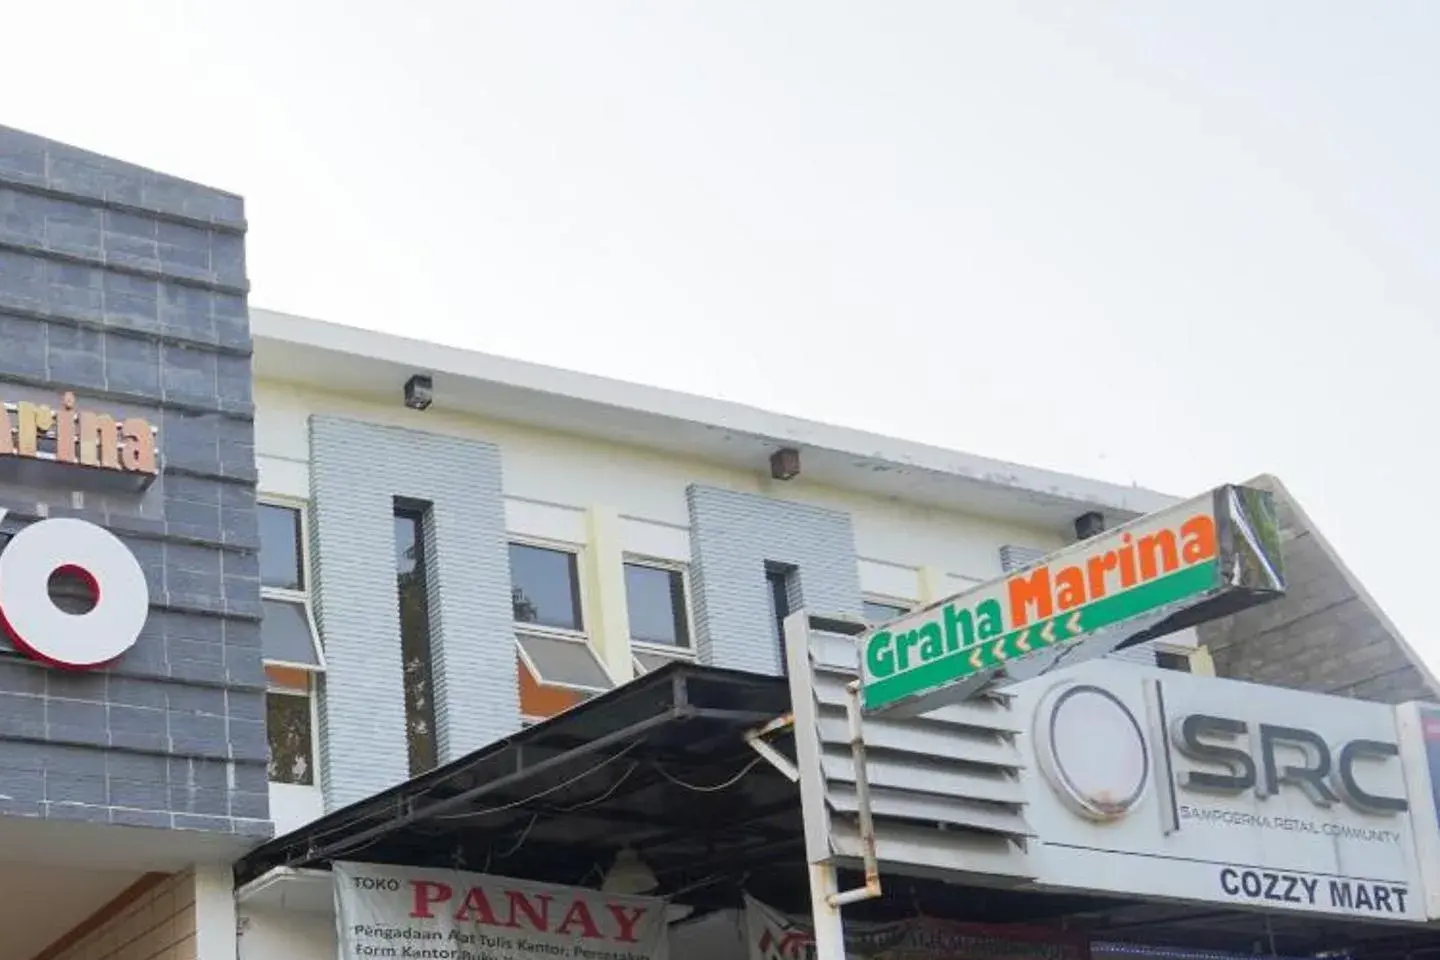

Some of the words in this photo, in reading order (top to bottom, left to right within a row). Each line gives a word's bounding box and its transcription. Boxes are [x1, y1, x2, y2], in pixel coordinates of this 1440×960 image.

[866, 598, 1003, 679] Graha
[1008, 514, 1216, 628] Marina
[1171, 714, 1409, 815] SRC
[1275, 816, 1322, 834] RETAIL
[1323, 822, 1401, 845] COMMUNITY
[354, 876, 400, 892] TOKO
[408, 879, 647, 943] PANAY
[1220, 868, 1318, 905] COZZY
[1329, 880, 1408, 913] MART
[354, 924, 443, 941] Pengadaan
[356, 944, 396, 957] Form
